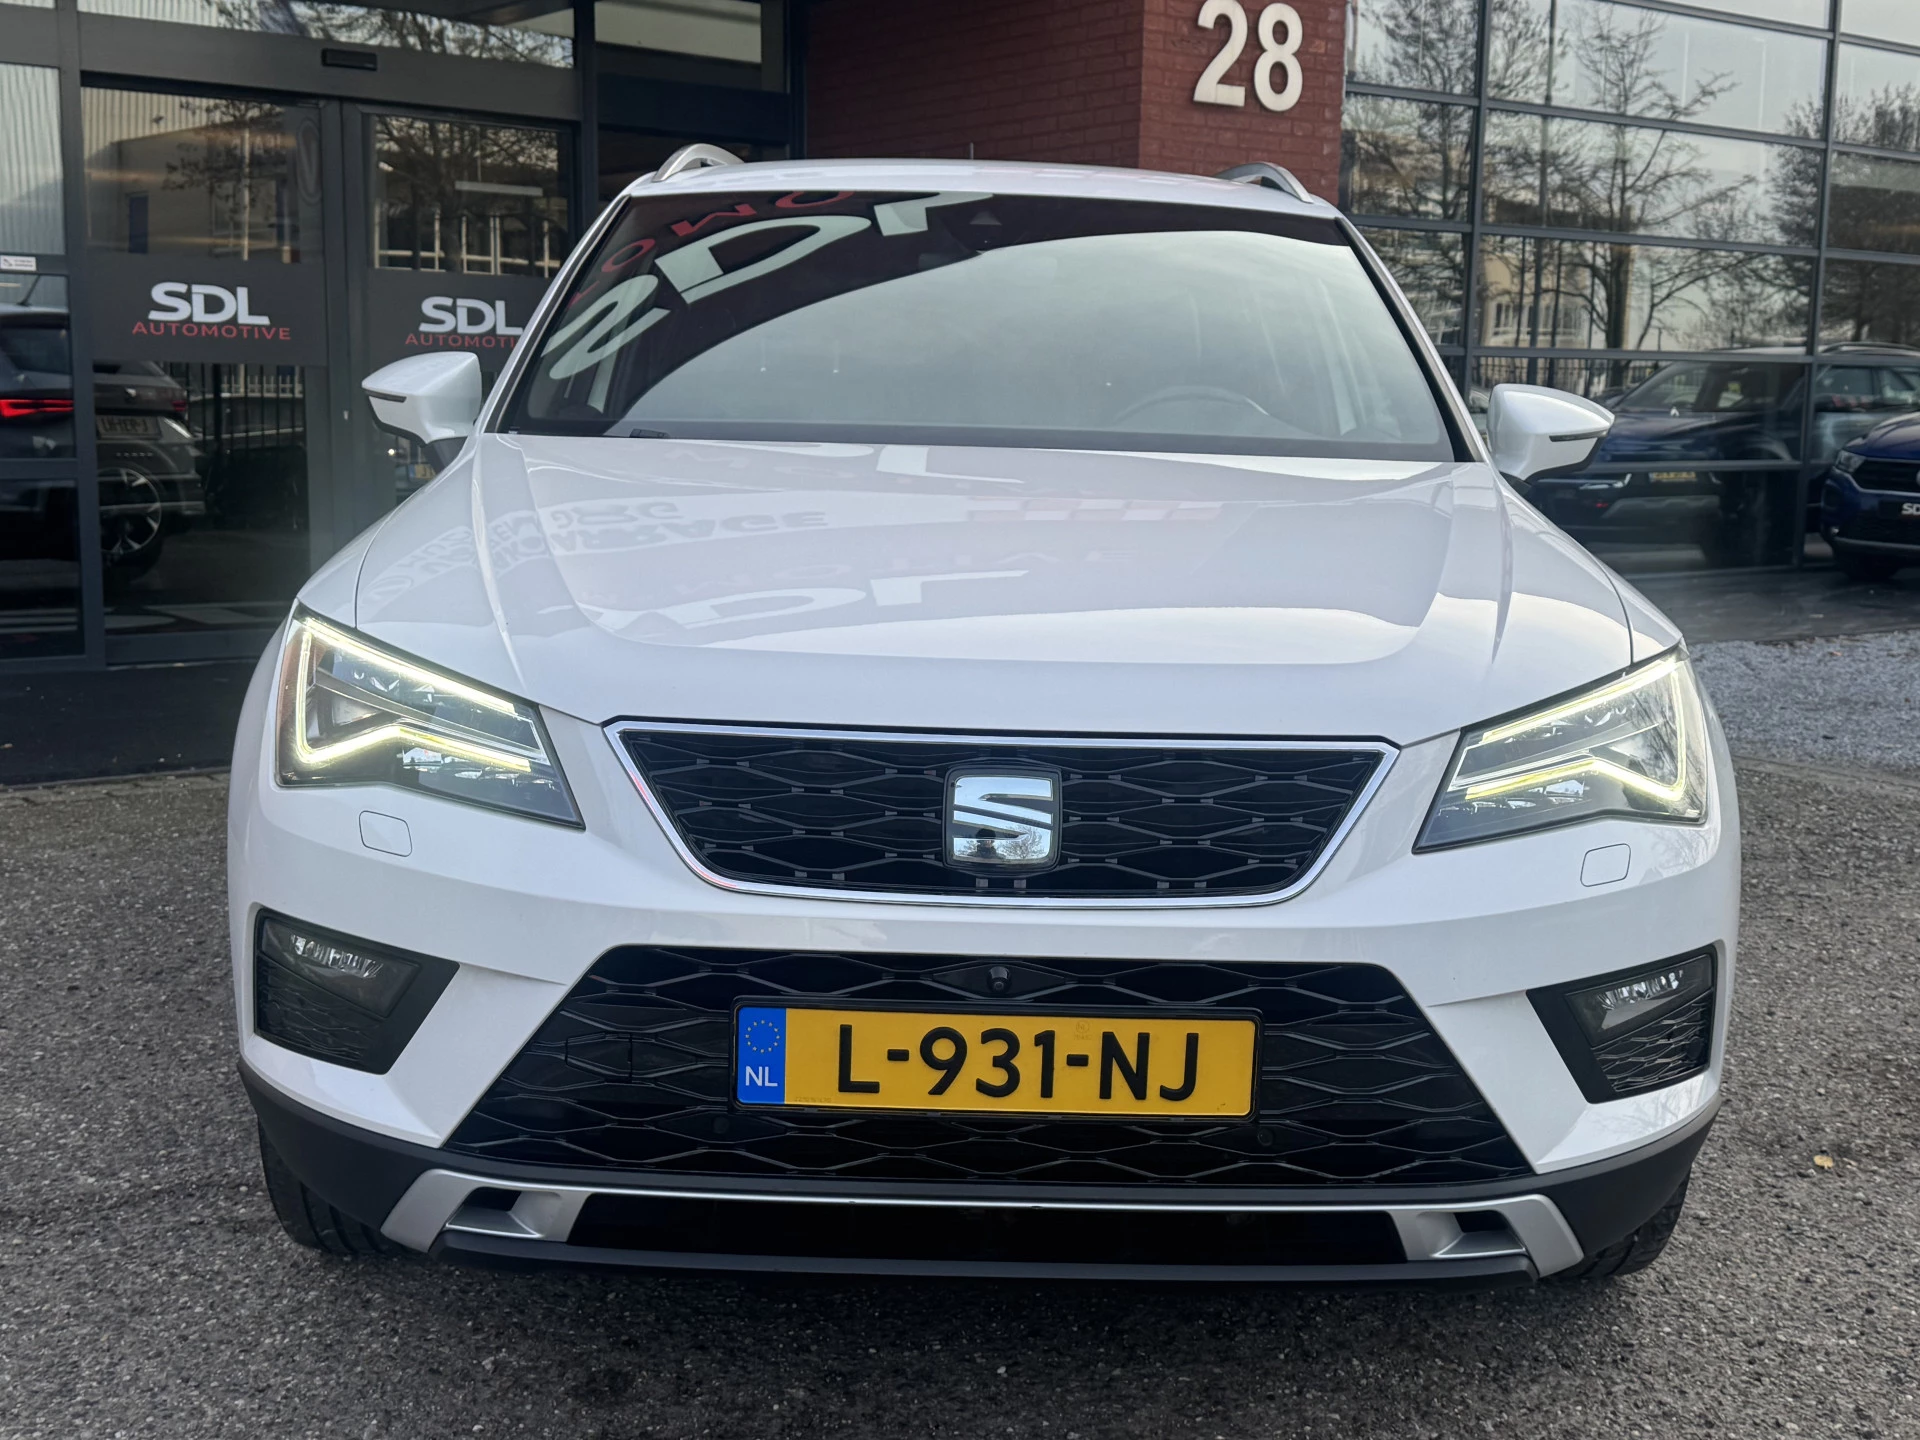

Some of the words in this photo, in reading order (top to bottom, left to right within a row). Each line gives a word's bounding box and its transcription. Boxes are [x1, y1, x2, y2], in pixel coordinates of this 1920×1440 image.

[1193, 0, 1303, 112] 28
[148, 281, 271, 325] SDL
[418, 296, 524, 335] SDL
[132, 321, 291, 340] AUTOMOTIVE
[405, 333, 519, 348] AUTOMOTI
[1901, 502, 1920, 516] SD
[745, 1065, 778, 1087] NL
[838, 1024, 1199, 1101] L-931-NJ
